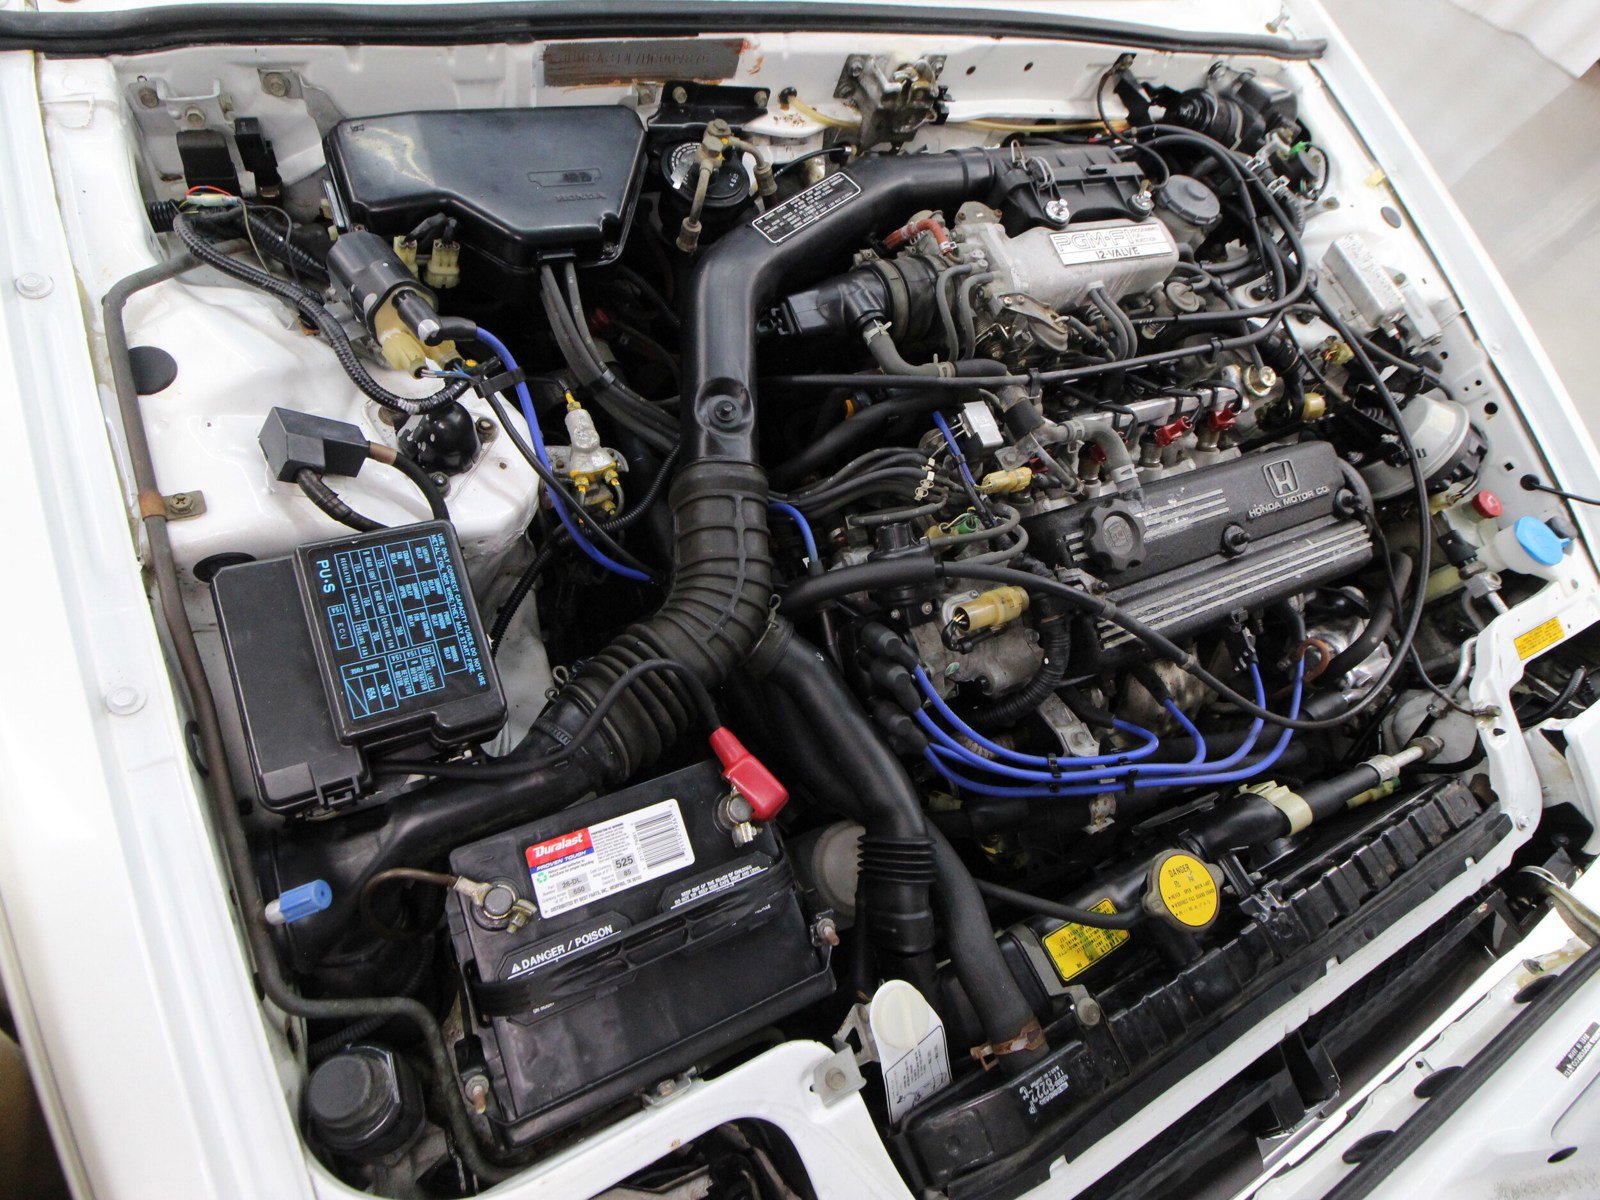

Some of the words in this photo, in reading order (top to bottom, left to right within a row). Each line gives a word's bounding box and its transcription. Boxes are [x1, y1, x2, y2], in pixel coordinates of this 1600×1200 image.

[1248, 501, 1280, 517] HONDA
[1282, 490, 1314, 506] MOTOR
[1315, 485, 1331, 495] CO.
[429, 534, 441, 555] METAL
[436, 532, 445, 545] USE
[388, 551, 398, 565] RELAY
[414, 546, 423, 560] RELAY
[440, 546, 450, 563] ONLY
[363, 555, 373, 568] HEAD
[376, 558, 385, 568] 15A
[339, 556, 352, 584] REGULATOR
[366, 567, 377, 581] LIGHT
[426, 578, 436, 592] RELAY
[440, 571, 450, 585] NOR
[445, 563, 459, 593] CORRECT
[372, 589, 382, 602] HEAD
[385, 591, 395, 602] 15A
[404, 583, 413, 597] RELAY
[376, 601, 386, 615] LIGHT
[449, 603, 460, 619] THEY
[454, 593, 467, 623] CAPACITY
[405, 614, 415, 628] RELAY
[429, 613, 439, 627] RELAY
[442, 610, 452, 625] POWER
[380, 617, 391, 637] COOLING
[386, 639, 394, 649] FAN
[454, 620, 464, 635] MAY
[354, 623, 365, 644] COOLING
[360, 645, 369, 656] FAN
[459, 636, 470, 657] START
[442, 646, 452, 660] RELAY
[469, 646, 477, 657] DO
[472, 657, 481, 671] NOT
[476, 671, 486, 686] USE
[364, 686, 377, 701] 65A
[379, 682, 392, 697] 35A
[532, 831, 585, 859] Duralast
[535, 857, 564, 871] PROVEN
[564, 849, 587, 861] TOUGH
[614, 854, 634, 869] 525
[1168, 863, 1191, 878] DANGER
[572, 884, 586, 895] 650
[521, 943, 566, 970] DANGER
[575, 924, 614, 949] POISON
